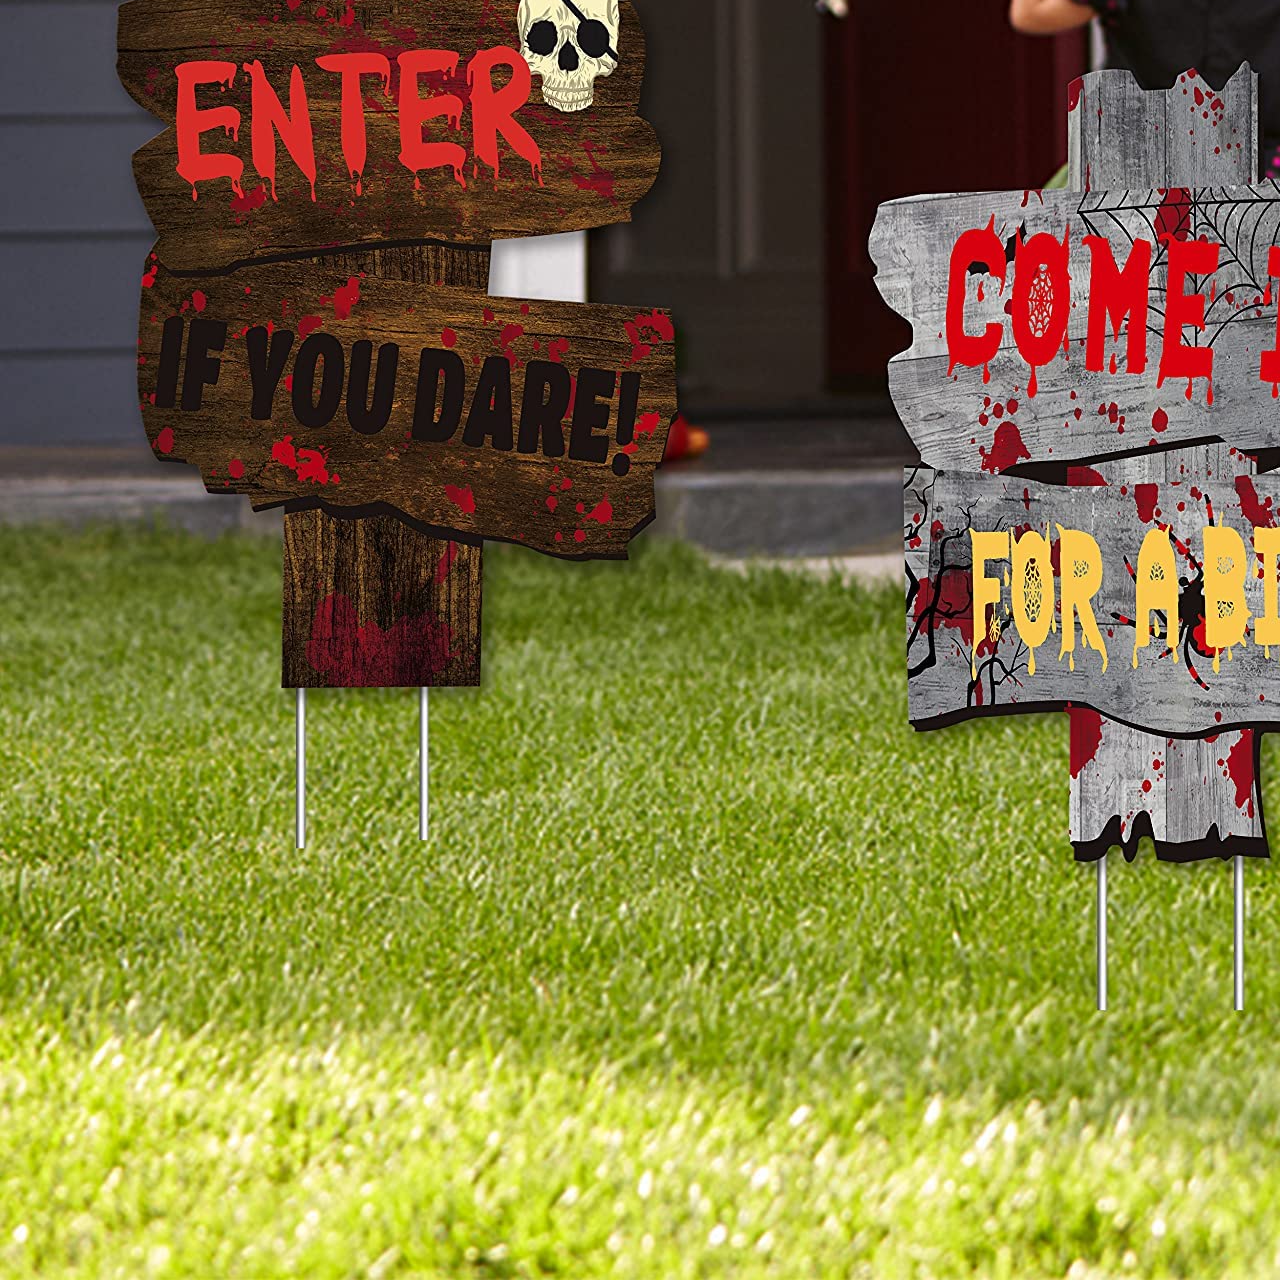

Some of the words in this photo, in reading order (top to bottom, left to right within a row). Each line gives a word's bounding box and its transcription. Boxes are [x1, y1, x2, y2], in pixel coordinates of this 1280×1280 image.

[175, 45, 543, 201] ENTER
[946, 214, 1220, 402] COME
[155, 317, 227, 412] IF
[245, 323, 399, 435] YOU
[412, 347, 642, 476] DARE!
[970, 521, 1108, 680] FOR
[1132, 523, 1180, 669] A
